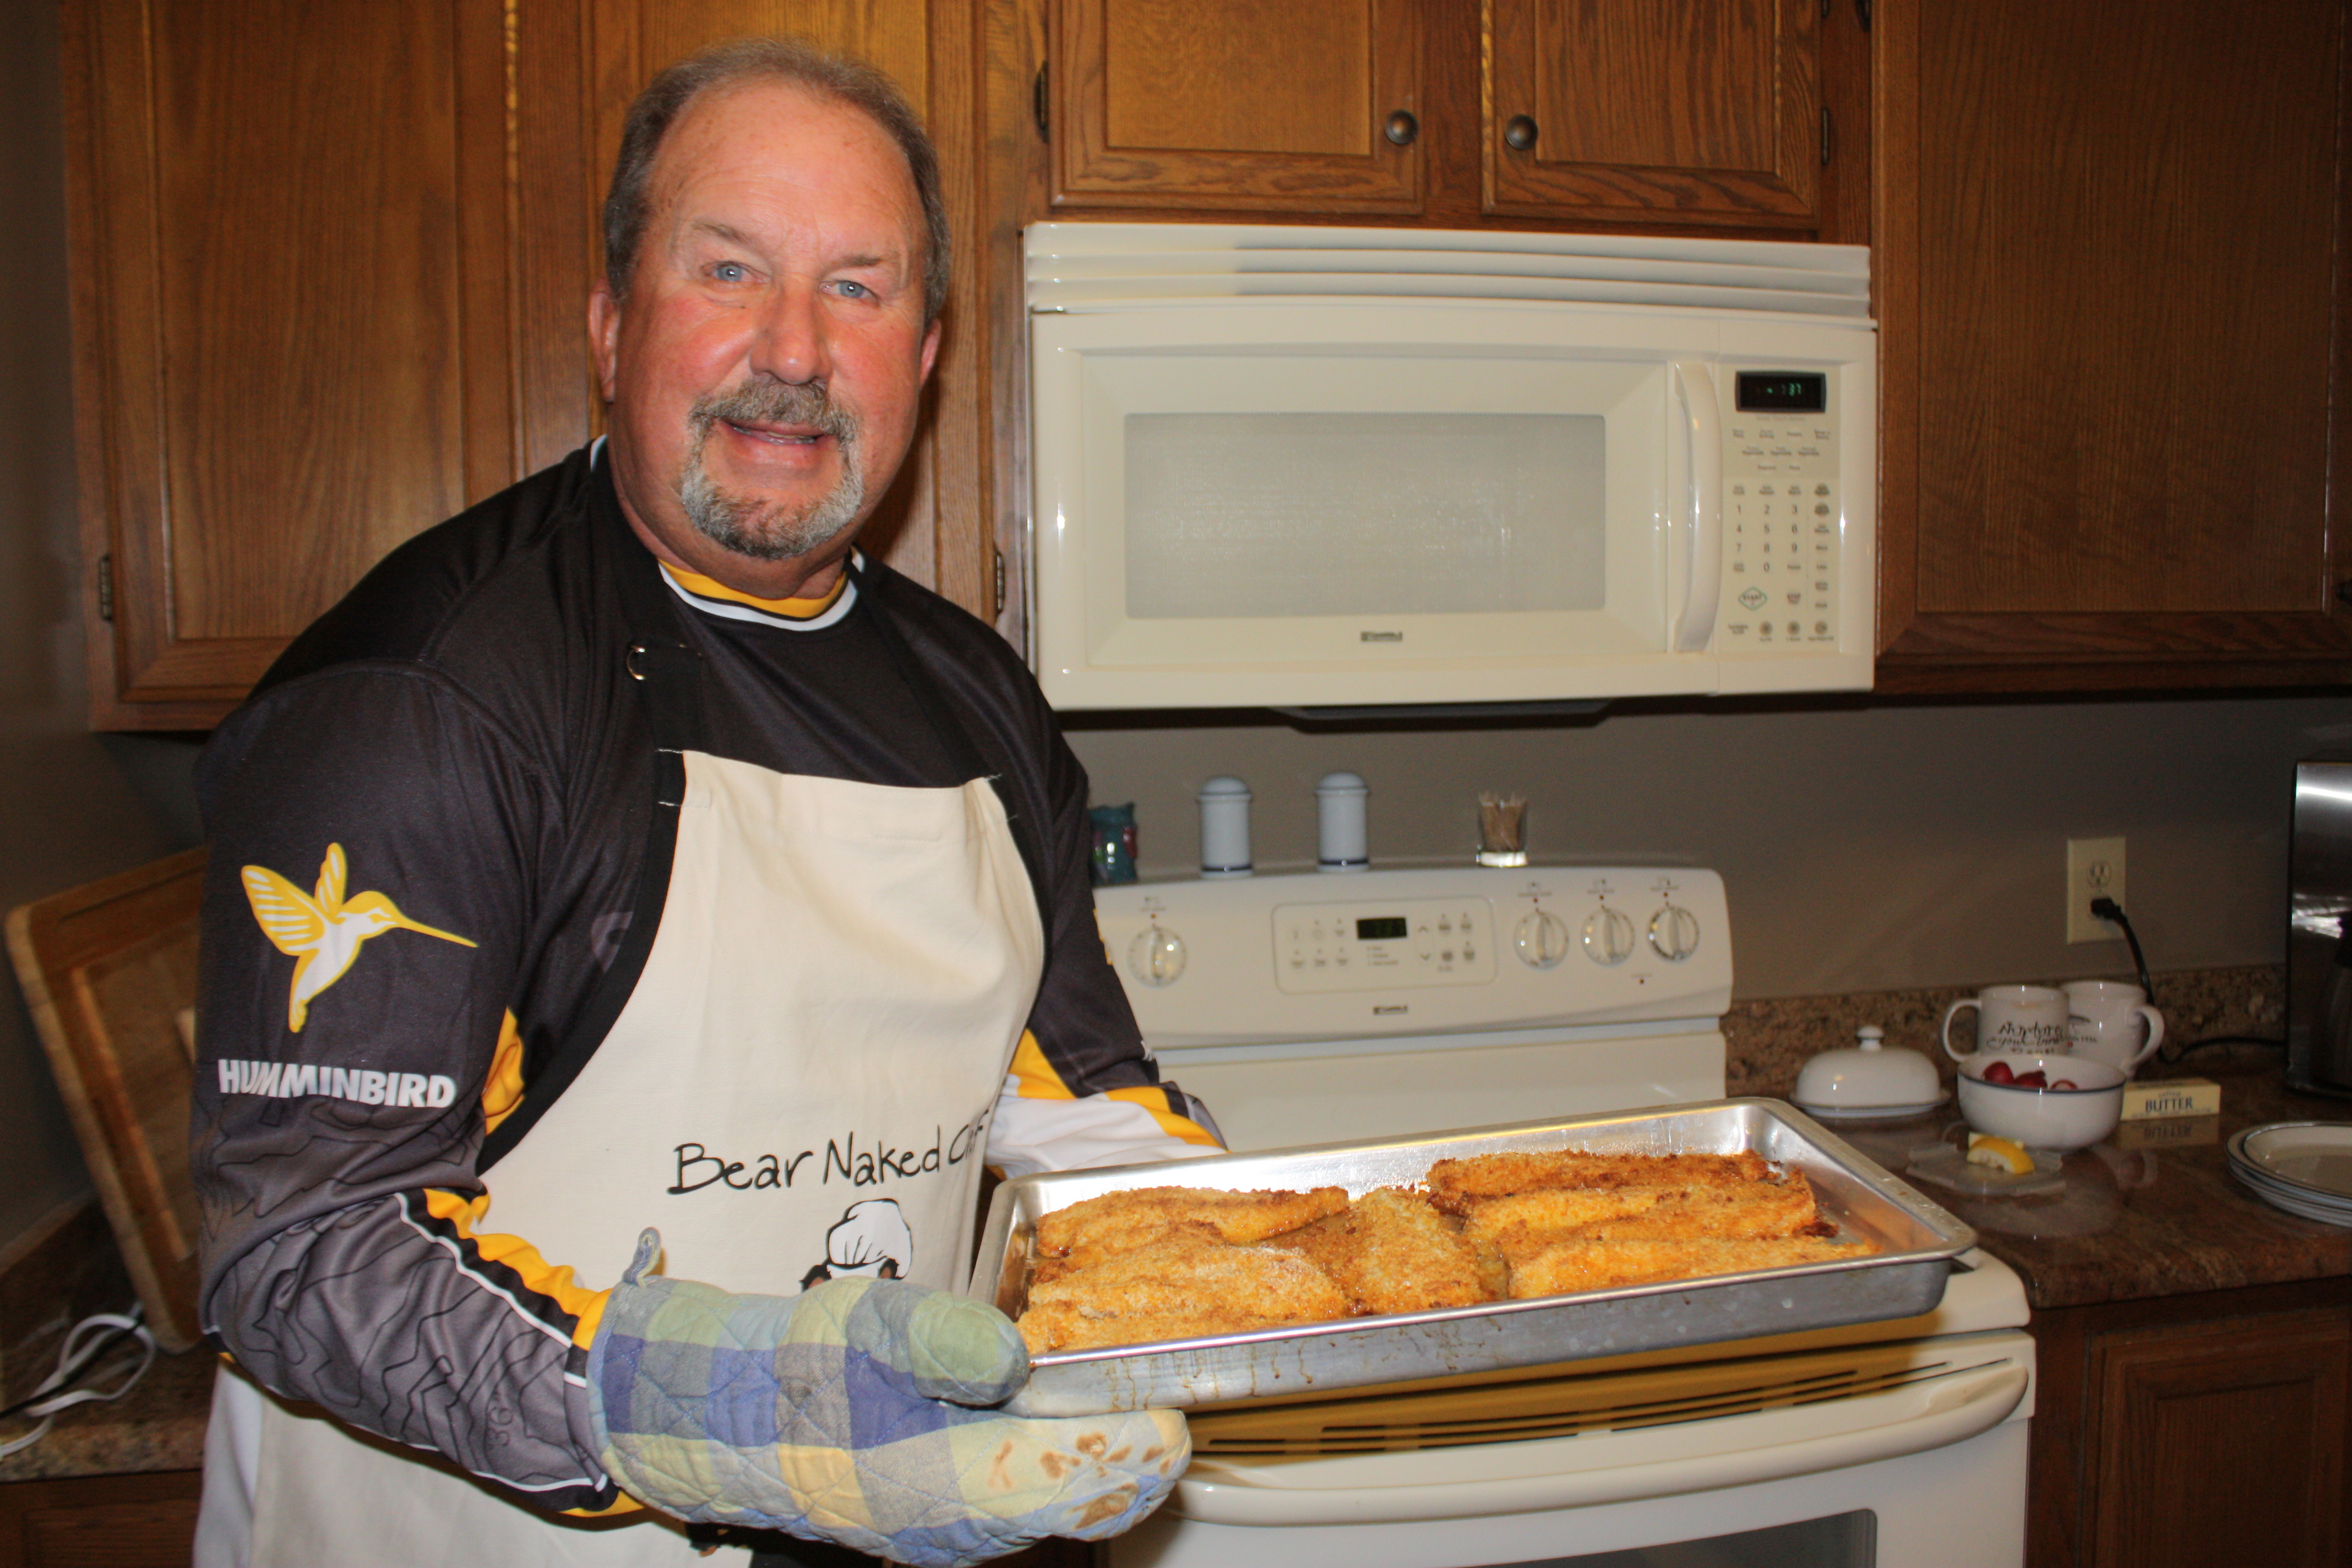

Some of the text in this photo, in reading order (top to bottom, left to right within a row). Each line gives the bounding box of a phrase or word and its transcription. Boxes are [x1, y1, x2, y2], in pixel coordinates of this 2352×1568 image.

[1736, 504, 1742, 515] 1
[1763, 504, 1771, 515] 2
[1791, 504, 1798, 515] 3
[1736, 524, 1743, 534] 4
[1763, 523, 1771, 534] 5
[1790, 523, 1798, 534] 6
[1736, 542, 1743, 553] 7
[1763, 542, 1771, 553] 8
[1790, 542, 1798, 553] 9
[1763, 561, 1771, 573] 0
[218, 1059, 457, 1108] HUMMINBIRD
[2145, 1096, 2193, 1113] BUTTER
[667, 1142, 814, 1195] Bear
[823, 1125, 940, 1188] Naked
